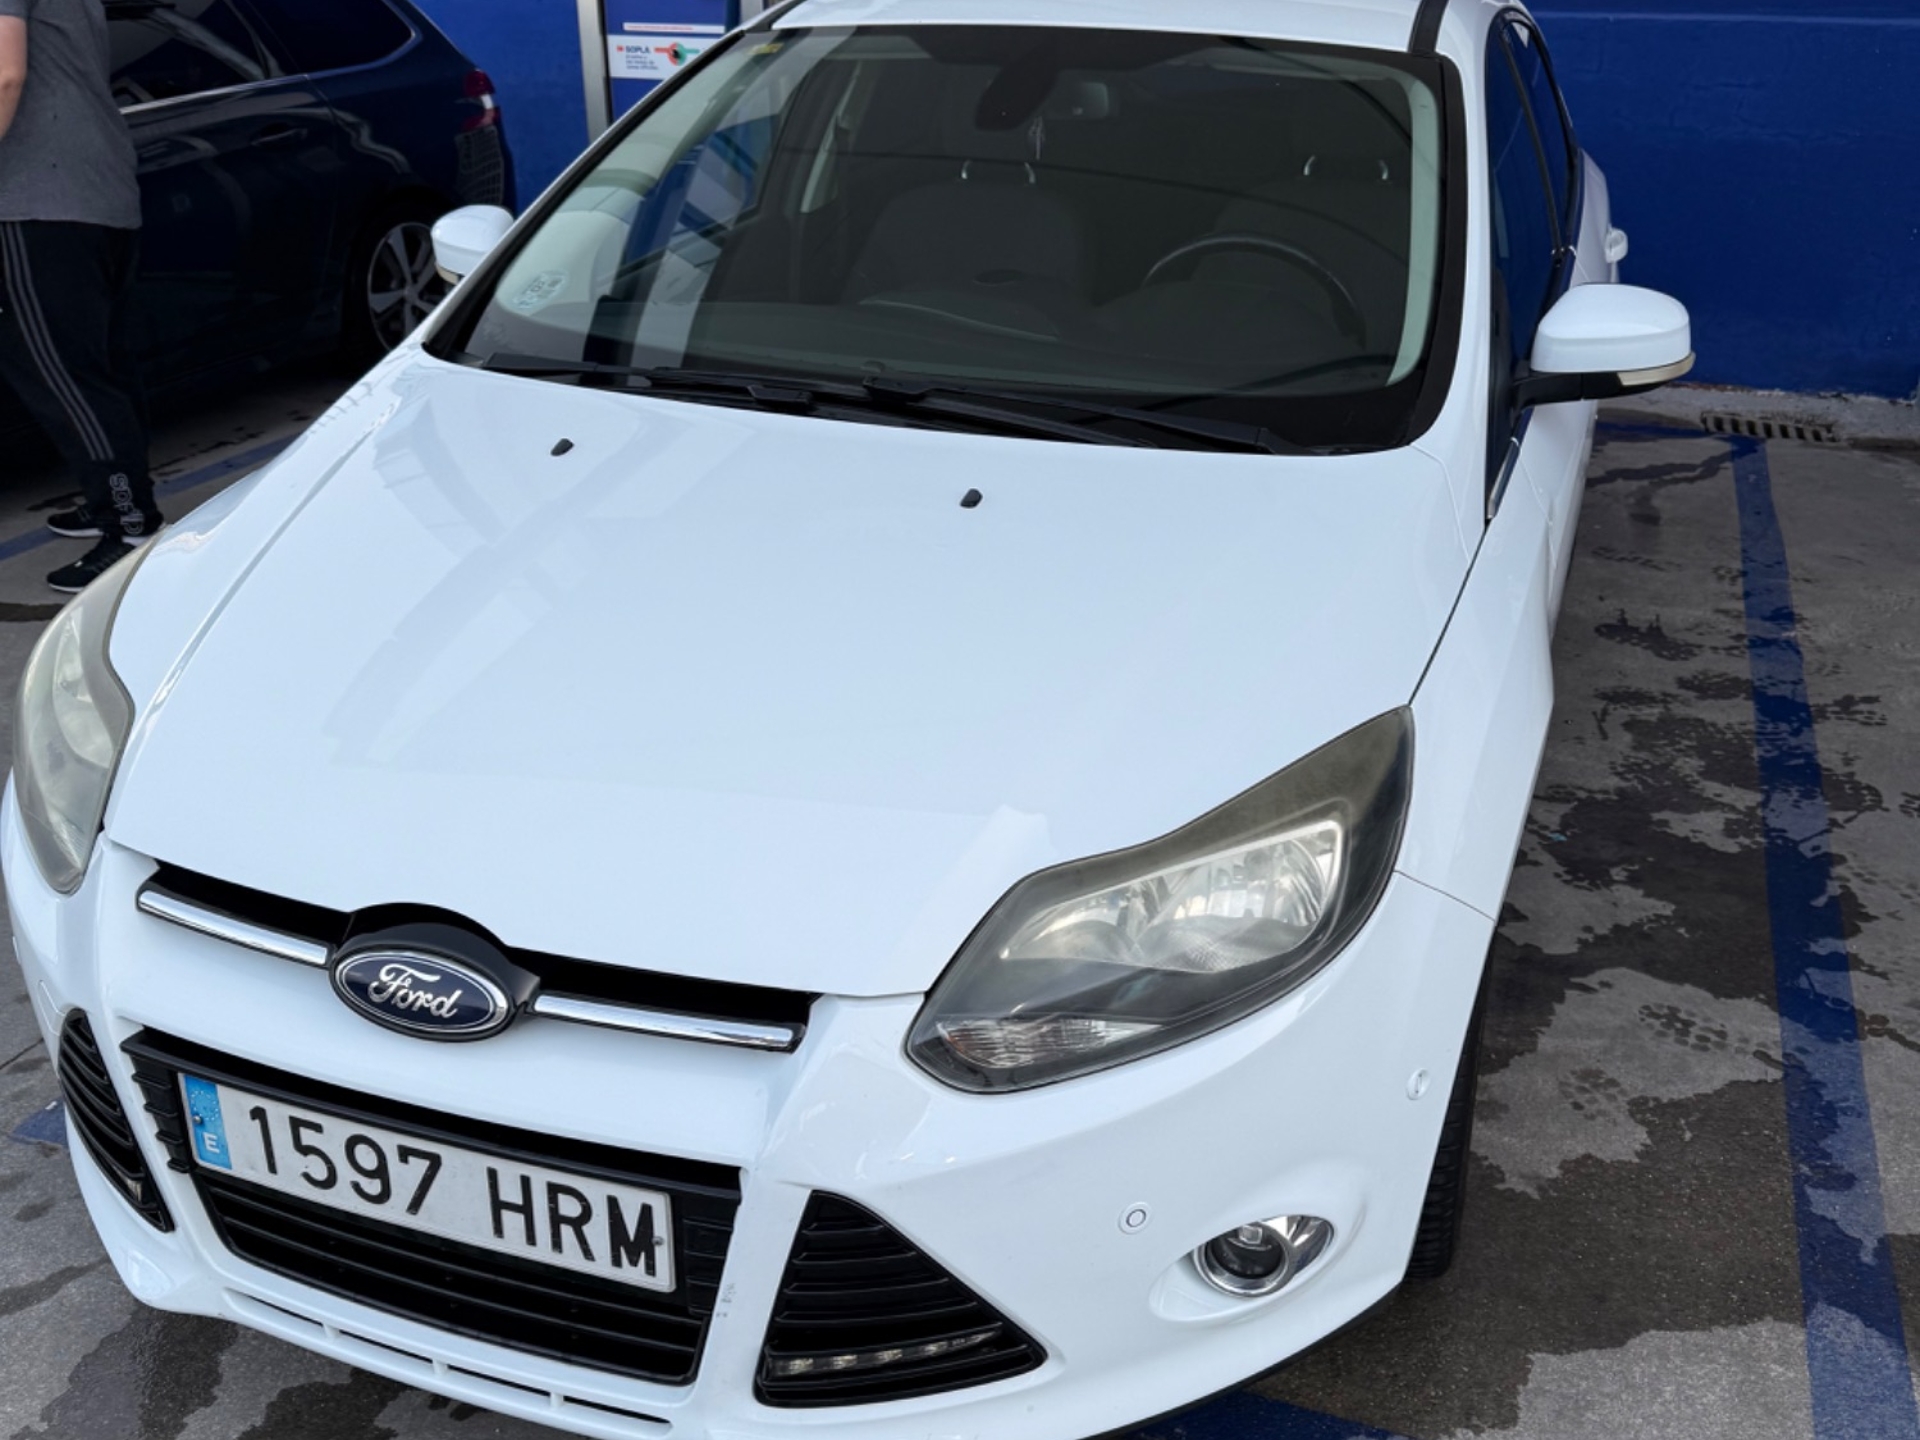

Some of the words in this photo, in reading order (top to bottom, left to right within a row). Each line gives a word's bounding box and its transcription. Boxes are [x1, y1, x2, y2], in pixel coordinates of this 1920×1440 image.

[367, 963, 462, 1018] Ford
[203, 1133, 220, 1154] E
[249, 1105, 442, 1216] 1597
[486, 1166, 657, 1277] HRM
